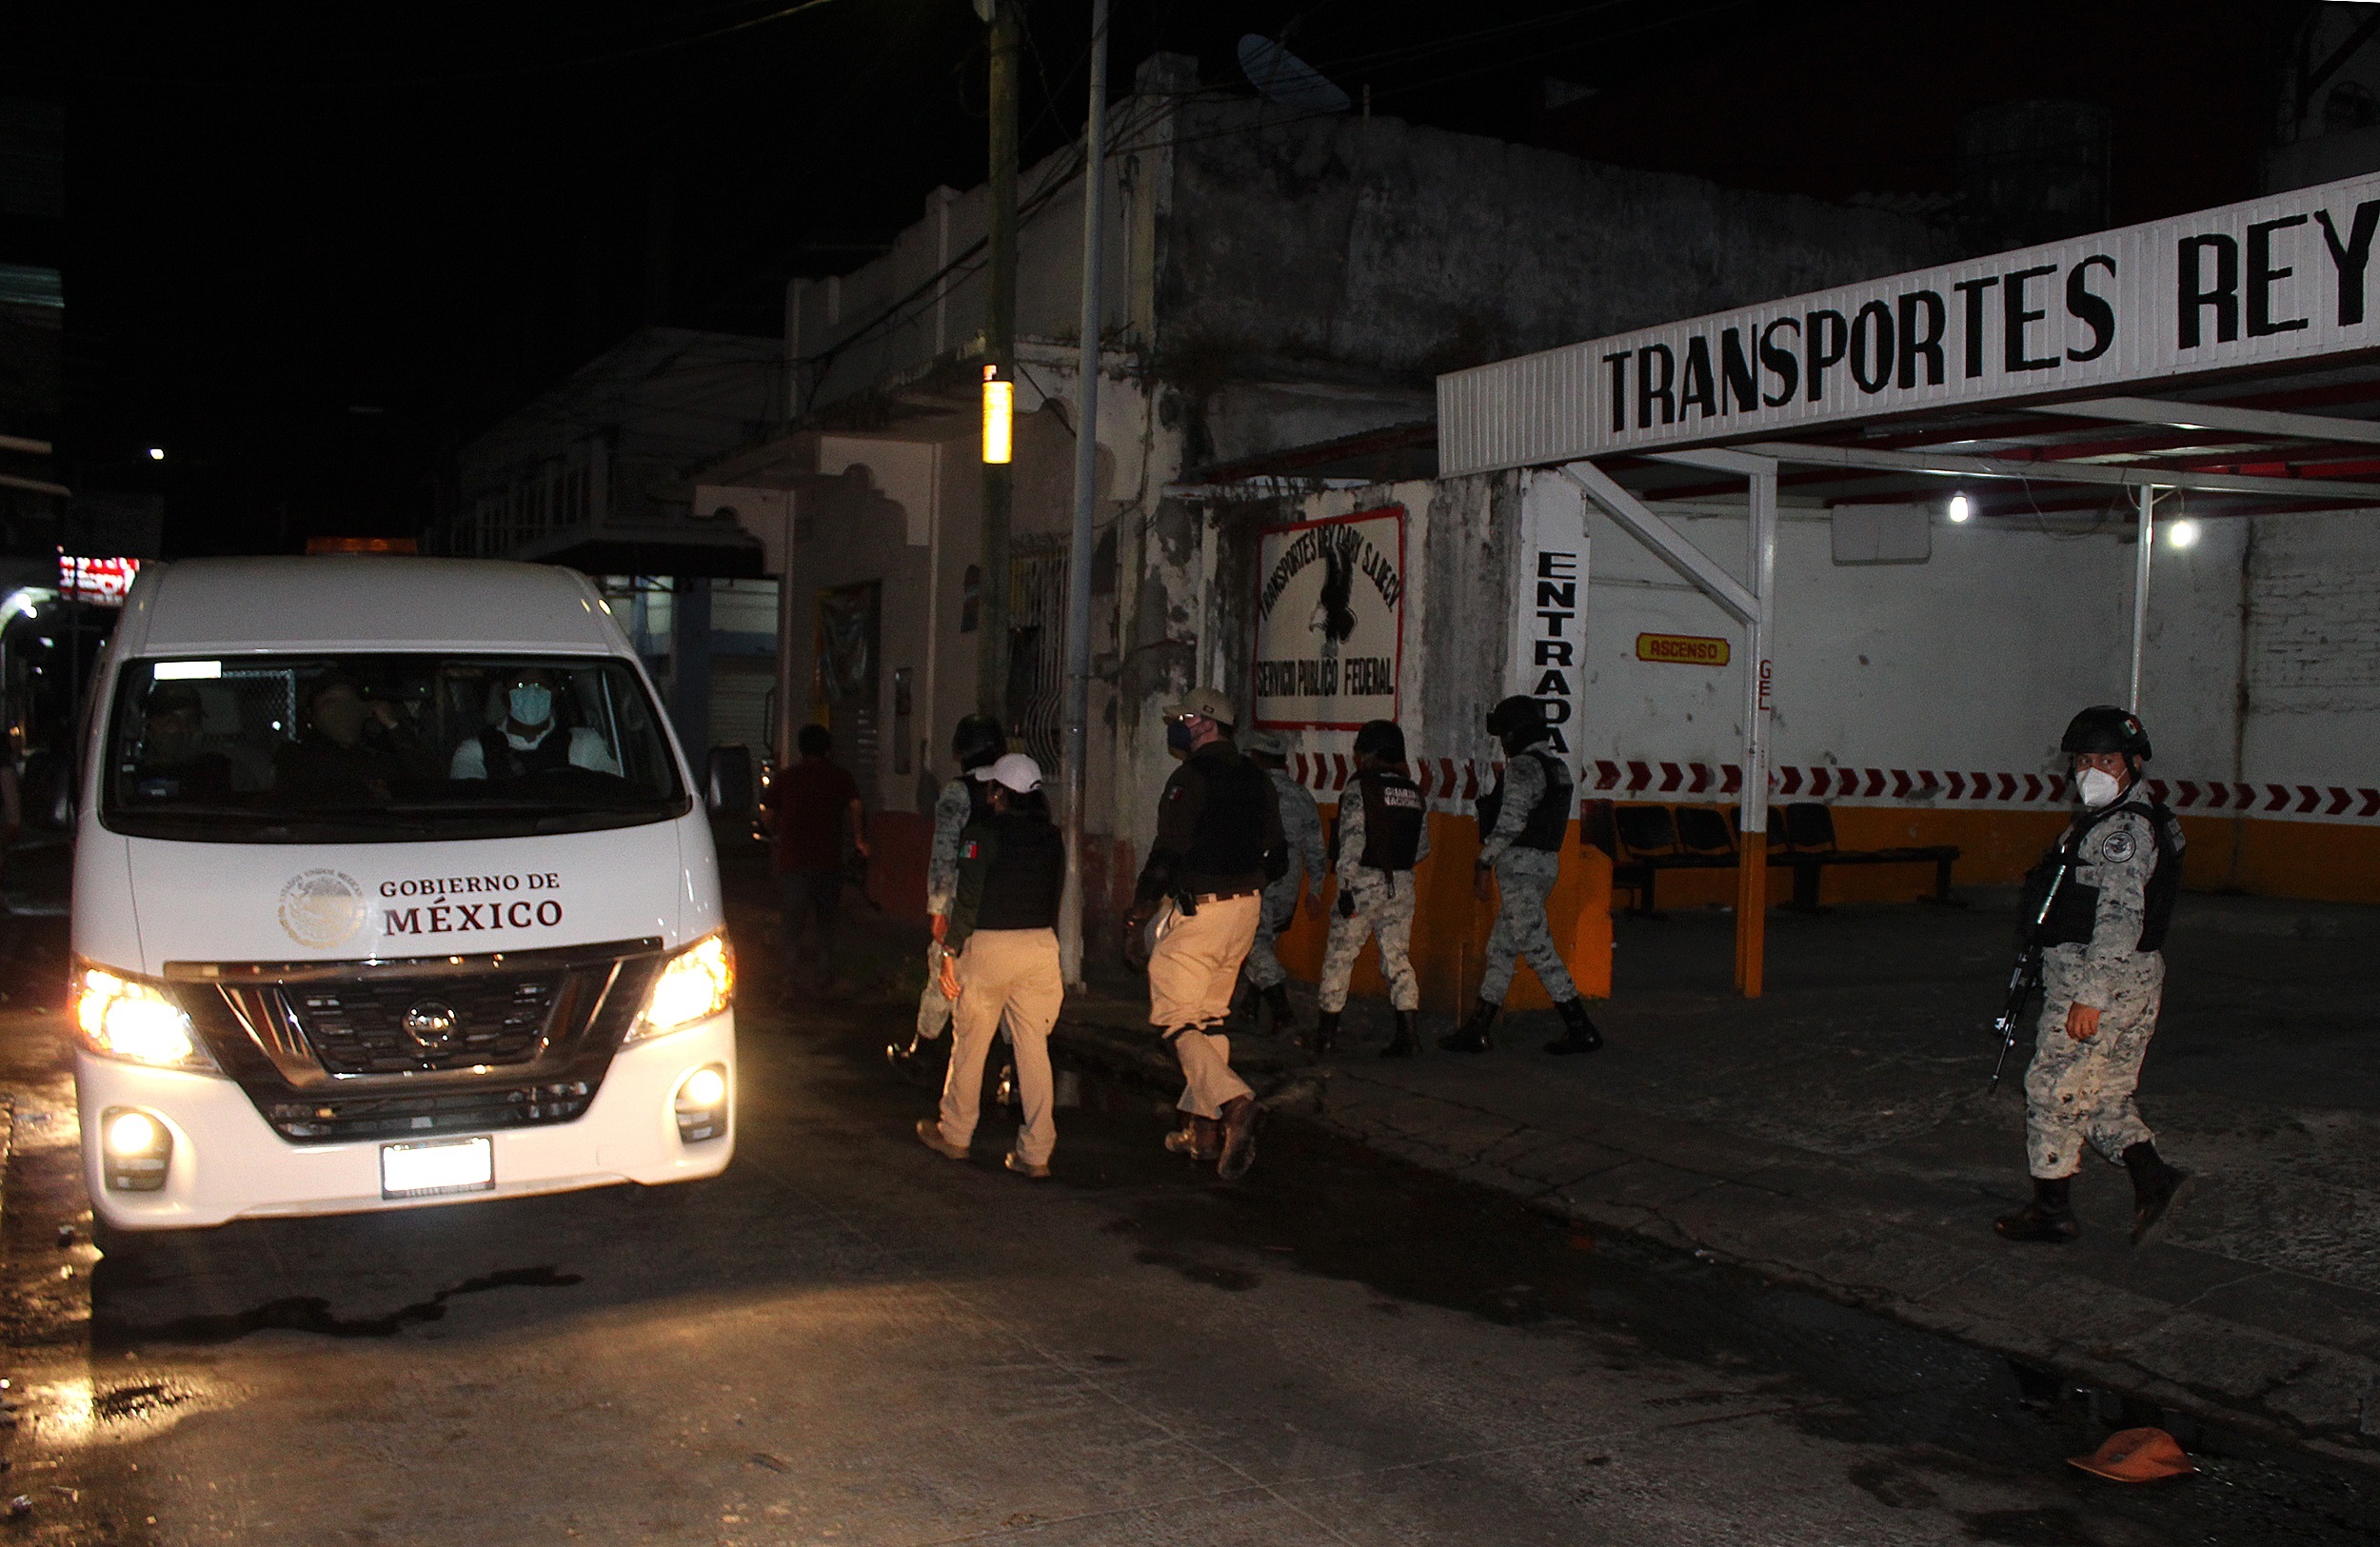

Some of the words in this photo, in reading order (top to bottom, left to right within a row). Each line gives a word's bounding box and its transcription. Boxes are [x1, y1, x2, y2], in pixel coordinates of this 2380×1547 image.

[1603, 254, 2116, 431] TRANSPORTES
[2178, 199, 2380, 349] REY
[1650, 640, 1717, 659] ASCENSO
[1344, 656, 1395, 696] FEDERAL
[1758, 659, 1772, 710] GEL
[380, 874, 520, 897] GOBIERNO
[528, 872, 560, 889] DE
[383, 897, 563, 937] MÉXICO
